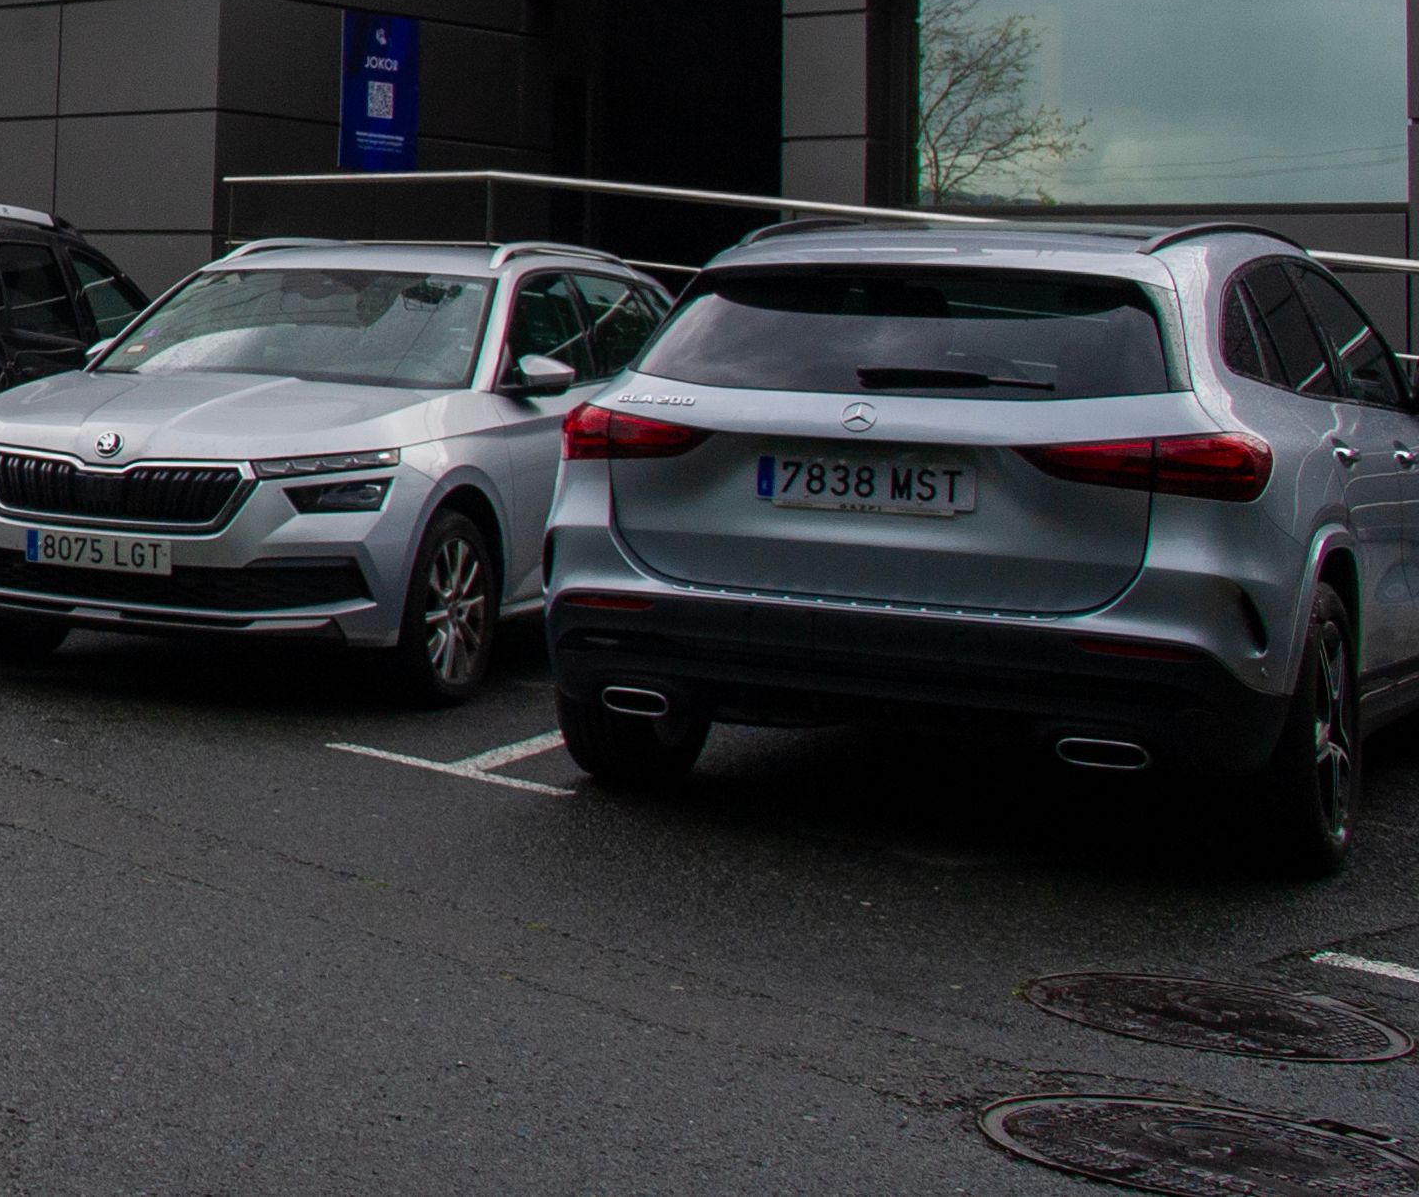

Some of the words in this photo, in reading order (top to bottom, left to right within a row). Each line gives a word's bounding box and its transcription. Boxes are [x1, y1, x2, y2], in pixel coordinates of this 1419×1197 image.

[618, 393, 653, 404] GLA
[656, 395, 696, 407] 200
[781, 461, 876, 499] 7838
[890, 467, 963, 504] MST
[43, 534, 104, 564] 8075
[114, 540, 163, 570] LGT
